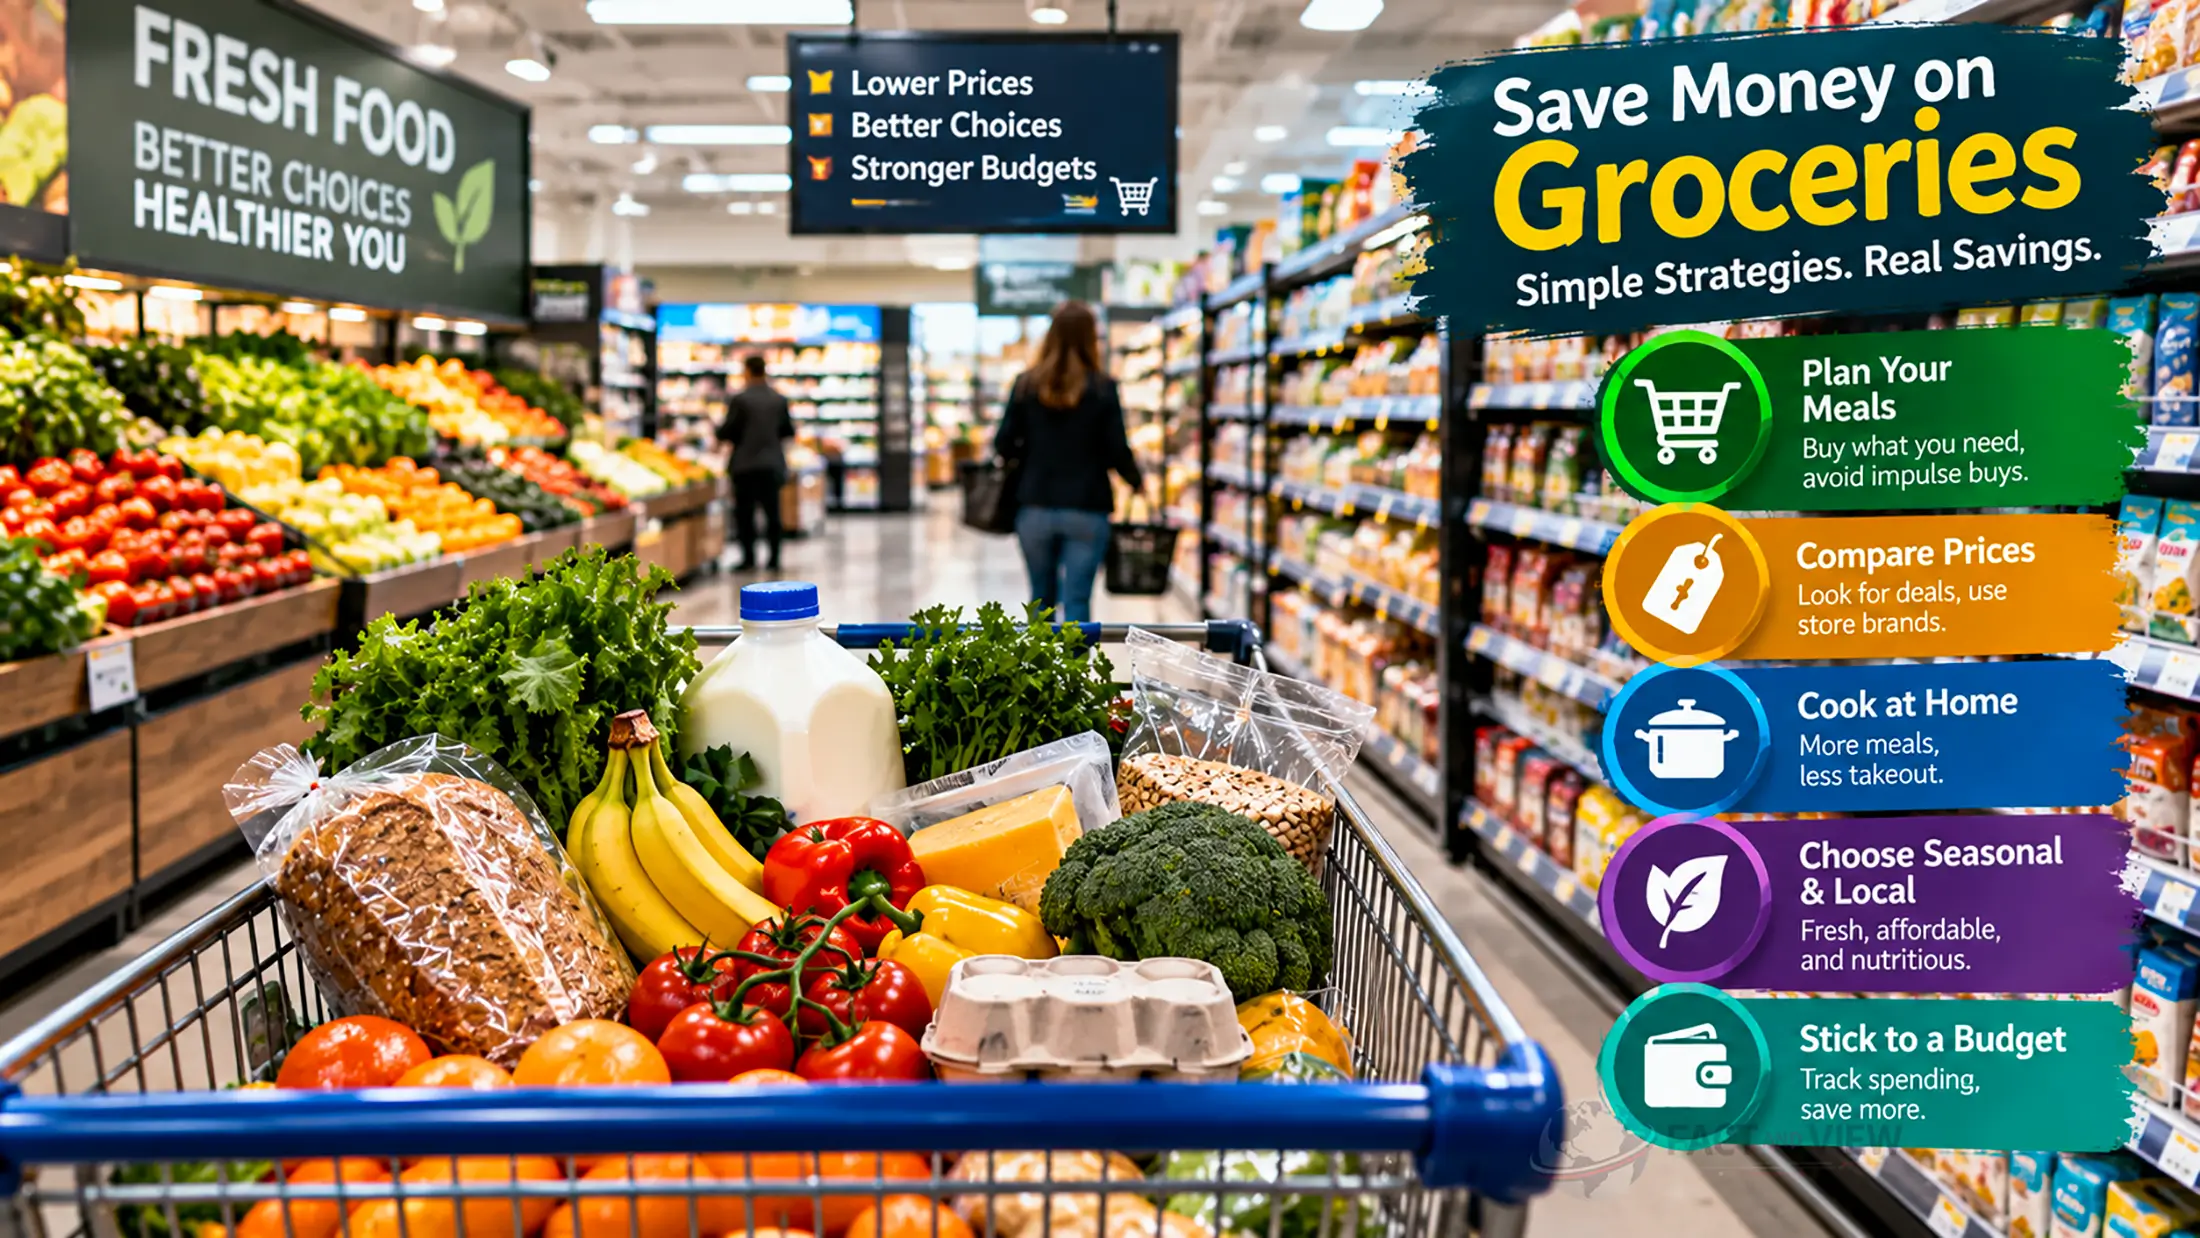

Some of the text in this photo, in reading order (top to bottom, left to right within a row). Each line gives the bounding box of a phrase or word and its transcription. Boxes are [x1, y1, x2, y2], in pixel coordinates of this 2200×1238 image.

[134, 5, 455, 174] FRESH FOOD
[852, 68, 1034, 96] Lower Prices
[852, 110, 1063, 138] Better Choices
[133, 119, 412, 228] BETTER CHOICES
[851, 153, 1097, 187] Stronger Budgets
[134, 177, 406, 274] HEALTHIER YOU
